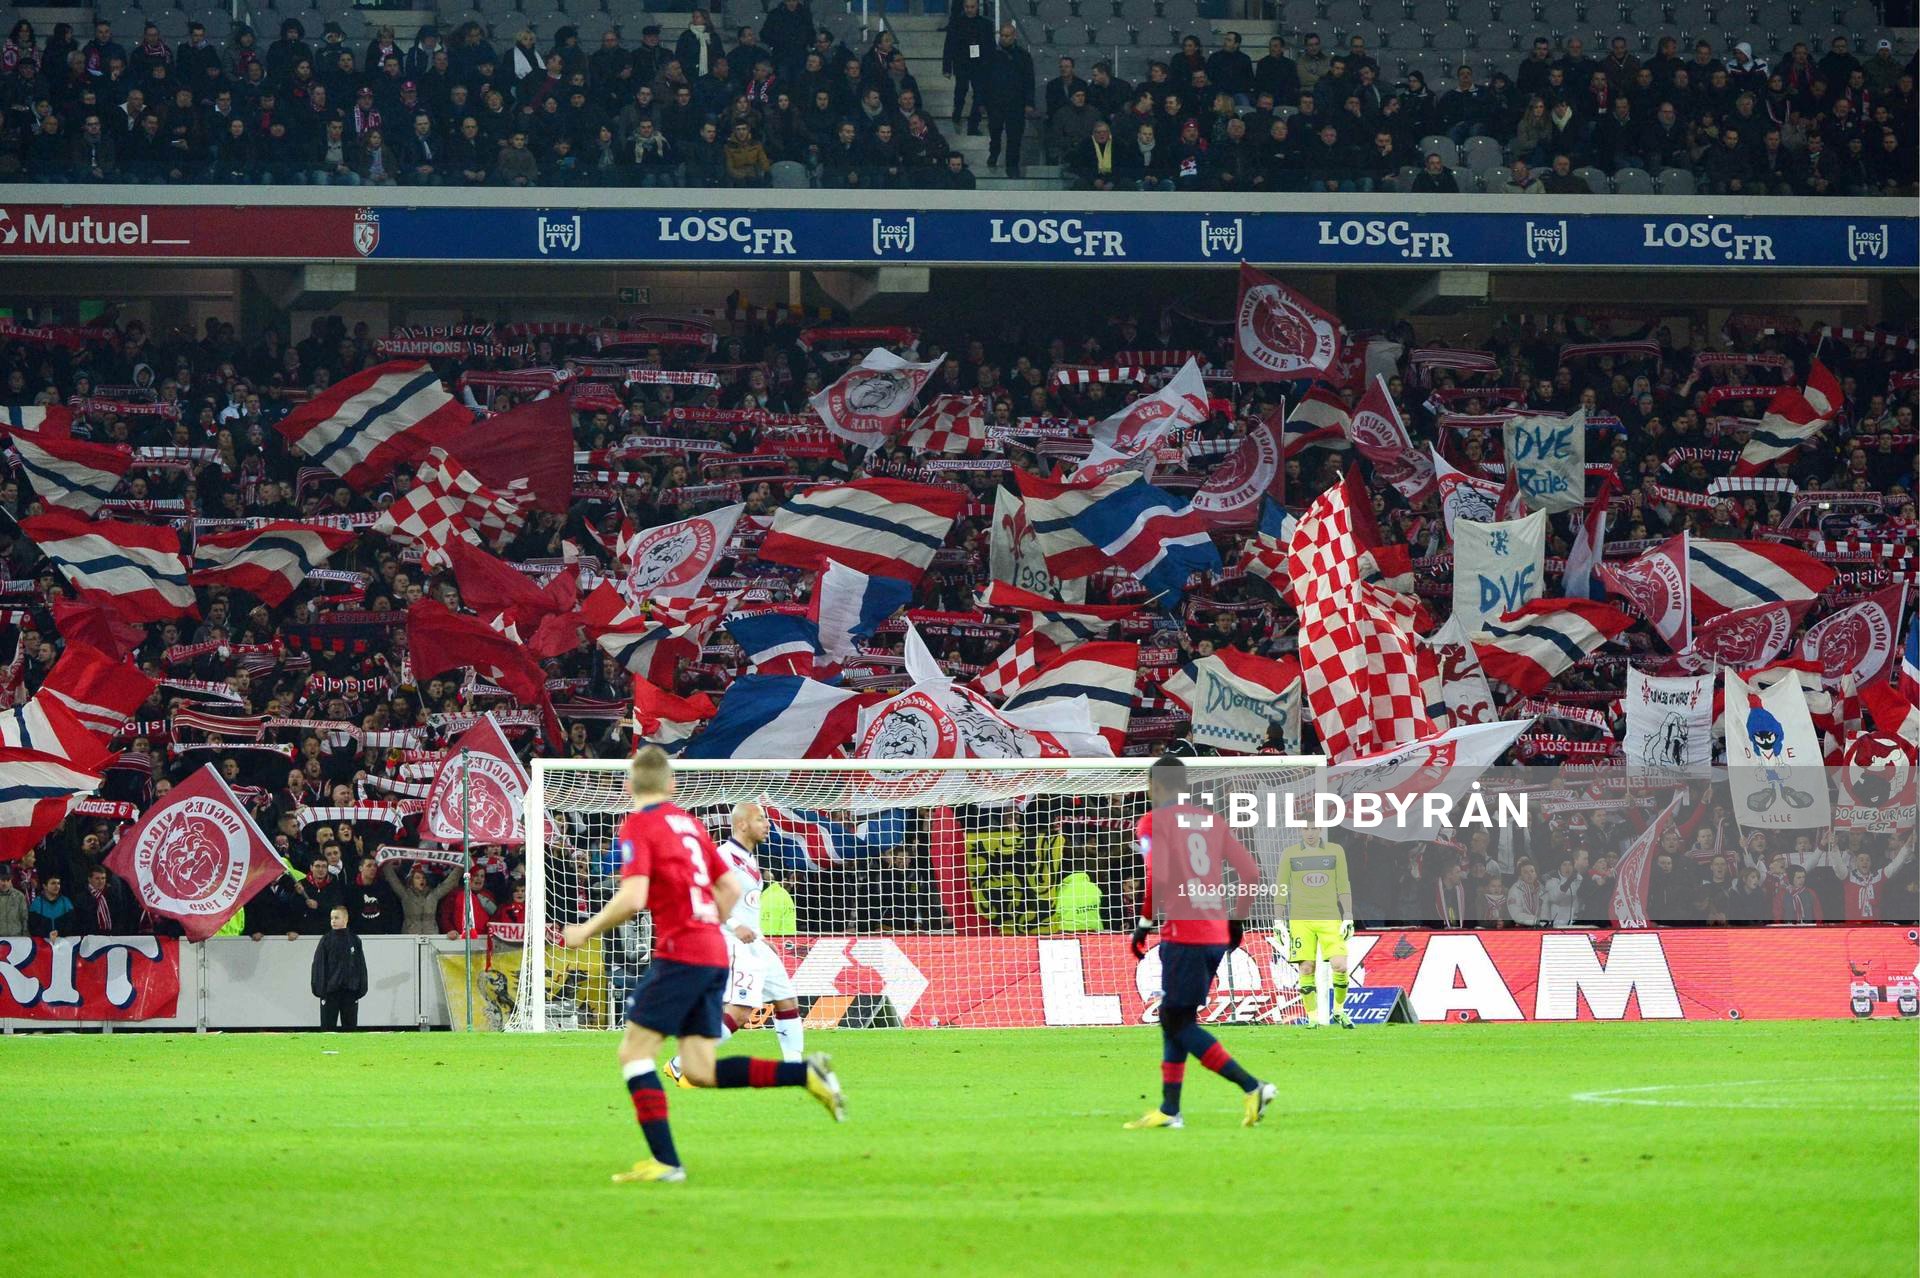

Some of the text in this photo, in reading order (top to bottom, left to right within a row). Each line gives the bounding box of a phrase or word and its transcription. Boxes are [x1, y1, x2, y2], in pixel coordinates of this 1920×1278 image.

[354, 213, 379, 222] LOSC
[24, 215, 148, 244] Mutuel
[546, 224, 573, 232] LOSC
[659, 217, 796, 254] LOSC.FR
[880, 225, 907, 233] LOSC
[1209, 227, 1236, 236] LOSC
[1534, 229, 1560, 237] LOSC
[1855, 231, 1882, 240] LOSC
[547, 233, 572, 248] TV
[881, 234, 907, 249] TV
[990, 219, 1126, 256] LOSC.FR
[1209, 236, 1236, 250] TV
[1318, 221, 1453, 258] LOSC.FR
[1535, 237, 1560, 252] TV
[1643, 223, 1776, 260] LOSC.FR
[1856, 241, 1880, 255] TV
[385, 341, 461, 353] CHAMPIONS
[1252, 346, 1289, 370] LILLE
[641, 437, 717, 450] ALLEZ LE LOSC
[1514, 424, 1574, 461] DVE
[1516, 467, 1569, 497] Rules
[1477, 562, 1536, 614] DVE
[939, 715, 956, 743] EST
[1540, 742, 1608, 754] LOSC LILLE
[1787, 747, 1797, 759] E
[1835, 806, 1916, 822] DOGUES VIRAGE
[1866, 822, 1890, 832] EST
[381, 848, 408, 860] DVE
[680, 835, 711, 888] 3
[1187, 832, 1211, 877] 8
[1306, 875, 1326, 883] KIA
[1291, 937, 1302, 949] 16
[735, 971, 754, 991] 22
